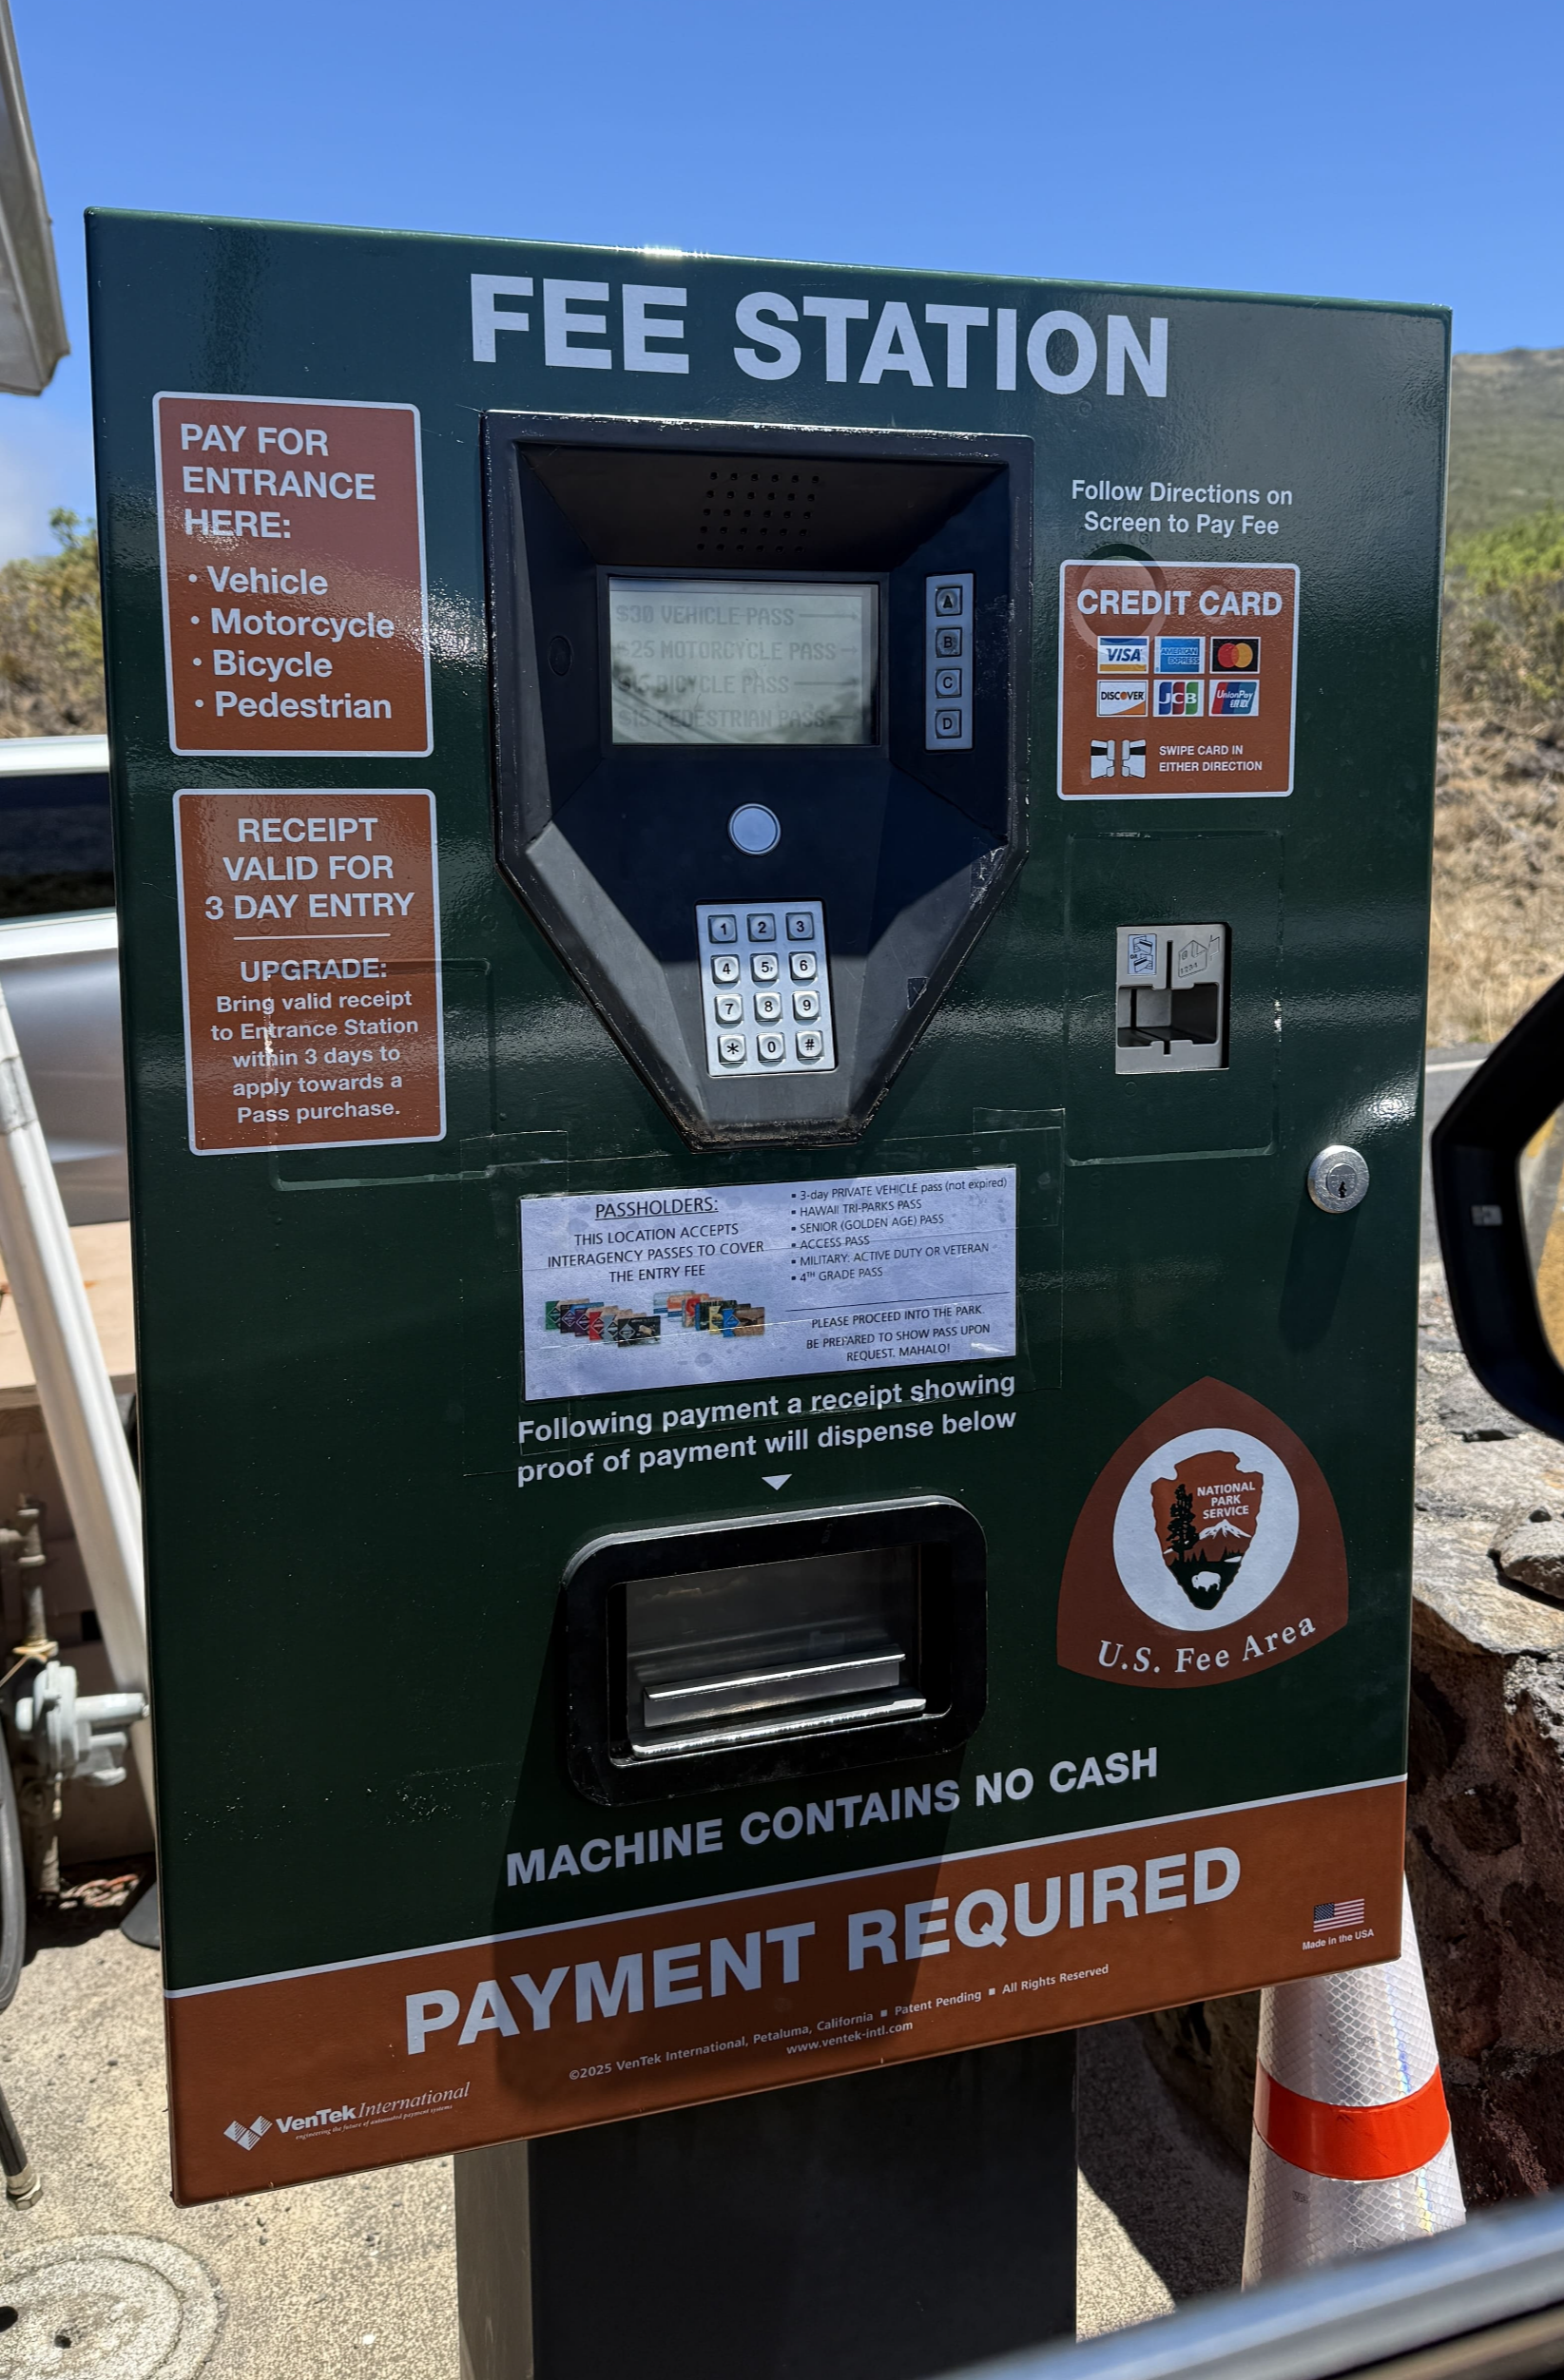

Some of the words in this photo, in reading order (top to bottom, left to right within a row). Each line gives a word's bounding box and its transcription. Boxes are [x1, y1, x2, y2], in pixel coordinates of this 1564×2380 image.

[471, 273, 689, 374] FEE
[733, 291, 1168, 397] STATION
[181, 423, 246, 451] PAY
[258, 428, 328, 456] FOR
[183, 468, 376, 501] ENTRANCE
[1072, 479, 1142, 503] Follow
[1150, 483, 1260, 506] Directions
[1266, 489, 1292, 506] on
[185, 510, 290, 539] HERE:
[1084, 511, 1161, 533] Screen
[1168, 514, 1189, 533] to
[1196, 515, 1234, 538] Pay
[1242, 516, 1279, 535] Fee
[207, 566, 328, 595] Vehicle
[1077, 589, 1191, 615] CREDIT
[1199, 590, 1283, 616] CARD
[210, 608, 394, 642] Motorcycle
[661, 605, 740, 625] VEHICLE
[746, 607, 794, 626] PASS
[661, 641, 782, 660] MOTORCYCLE
[789, 643, 836, 661] PASS
[1107, 648, 1142, 662] VISA
[1161, 647, 1199, 656] AMERICAN
[213, 650, 332, 681] Bicycle
[216, 692, 392, 719] Pedestrian
[1101, 691, 1144, 701] DISCOVER
[1158, 692, 1197, 704] JCB
[1217, 690, 1253, 700] UnionPay
[1159, 746, 1194, 756] SWIPE
[1197, 745, 1228, 756] CARD
[1232, 745, 1243, 755] IN
[1159, 761, 1199, 772] EITHER
[1203, 761, 1262, 772] DIRECTION
[239, 817, 377, 843] RECEIPT
[222, 856, 318, 881] VALID
[329, 855, 394, 879] FOR
[205, 895, 224, 920] 3
[235, 894, 299, 920] DAY
[309, 892, 415, 918] ENTRY
[721, 923, 726, 935] 1
[758, 922, 766, 933] 2
[797, 921, 804, 932] 3
[241, 958, 387, 983] UPGRADE:
[723, 963, 731, 974] 4
[800, 960, 807, 970] 6
[217, 996, 275, 1014] Bring
[281, 993, 332, 1010] valid
[338, 990, 412, 1011] receipt
[725, 1003, 733, 1014] 7
[764, 1001, 772, 1012] 8
[803, 1000, 811, 1010] 9
[211, 1025, 233, 1041] to
[241, 1022, 338, 1040] Entrance
[344, 1018, 417, 1035] Station
[232, 1049, 298, 1068] within
[305, 1048, 318, 1065] 3
[324, 1046, 373, 1065] days
[379, 1046, 400, 1062] to
[233, 1078, 292, 1100] apply
[298, 1073, 384, 1093] towards
[391, 1075, 402, 1088] a
[238, 1106, 289, 1123] Pass
[297, 1103, 400, 1123] purchase.
[801, 1189, 828, 1201] 3-day
[832, 1187, 872, 1199] PRIVATE
[876, 1183, 917, 1196] VEHICLE
[921, 1182, 942, 1195] pass
[945, 1180, 965, 1192] (not
[968, 1178, 1007, 1191] expired)
[595, 1197, 718, 1219] PASSHOLDERS:
[801, 1206, 839, 1217] HAWAII
[843, 1201, 894, 1214] TRI-PARKS
[898, 1200, 921, 1210] PASS
[574, 1233, 603, 1246] THIS
[608, 1228, 675, 1244] LOCATION
[681, 1223, 739, 1238] ACCEPTS
[801, 1221, 838, 1233] SENIOR
[840, 1219, 888, 1232] (GOLDEN
[893, 1215, 917, 1227] AGE)
[920, 1214, 944, 1224] PASS
[548, 1250, 643, 1268] INTERAGENCY
[647, 1246, 693, 1260] PASSES
[698, 1245, 715, 1257] TO
[720, 1241, 764, 1255] COVER
[801, 1238, 841, 1250] ACCESS
[845, 1236, 870, 1246] PASS
[801, 1254, 850, 1266] MILITARY:
[854, 1251, 890, 1261] ACTIVE
[894, 1248, 922, 1258] DUTY
[926, 1246, 940, 1256] OR
[943, 1242, 989, 1256] VETERAN
[609, 1271, 633, 1282] THE
[639, 1267, 680, 1280] ENTRY
[685, 1265, 705, 1276] FEE
[800, 1271, 816, 1282] 4TH
[819, 1270, 855, 1280] GRADE
[859, 1267, 882, 1277] PASS
[811, 1317, 849, 1329] PLEASE
[853, 1312, 901, 1325] PROCEED
[904, 1309, 930, 1319] INTO
[933, 1307, 952, 1317] THE
[956, 1304, 985, 1315] PARK.
[806, 1338, 819, 1349] BE
[823, 1334, 875, 1348] PREPARED
[879, 1332, 893, 1342] TO
[897, 1329, 929, 1340] SHOW
[933, 1326, 957, 1337] PASS
[961, 1324, 990, 1334] UPON
[847, 1348, 895, 1362] REQUEST.
[899, 1343, 950, 1356] MAHALO!
[518, 1410, 652, 1445] Following
[662, 1395, 778, 1433] payment
[787, 1396, 802, 1414] a
[811, 1382, 903, 1412] receipt
[909, 1372, 1015, 1404] showing
[517, 1451, 596, 1488] proof
[603, 1447, 629, 1470] of
[639, 1435, 756, 1474] payment
[764, 1429, 808, 1454] will
[818, 1416, 934, 1451] dispense
[942, 1410, 1016, 1436] below
[1197, 1482, 1255, 1497] NATIONAL
[1211, 1495, 1241, 1507] PARK
[1203, 1506, 1249, 1520] SERVICE
[1098, 1640, 1160, 1673] U.S.
[1175, 1647, 1229, 1673] Fee
[1242, 1616, 1316, 1661] Area
[506, 1817, 724, 1889] MACHINE
[740, 1777, 961, 1846] CONTAINS
[975, 1767, 1035, 1808] NO
[1048, 1746, 1160, 1792] CASH
[405, 1921, 816, 2057] PAYMENT
[848, 1845, 1242, 1973] REQUIRED
[1302, 1939, 1326, 1950] Made
[1328, 1936, 1337, 1945] in
[1339, 1934, 1353, 1943] the
[1355, 1929, 1375, 1940] USA
[616, 2051, 662, 2072] VenTek
[666, 2035, 748, 2062] International,
[753, 2024, 813, 2045] Petaluma,
[817, 2011, 873, 2032] California
[895, 1999, 933, 2017] Patent
[936, 1988, 982, 2010] Pending
[1002, 1983, 1017, 1995] All
[1021, 1973, 1056, 1995] Rights
[1059, 1964, 1109, 1985] Reserved
[786, 2019, 914, 2056] www.ventek-intl.com
[276, 2105, 357, 2134] VenTek
[357, 2082, 471, 2119] International
